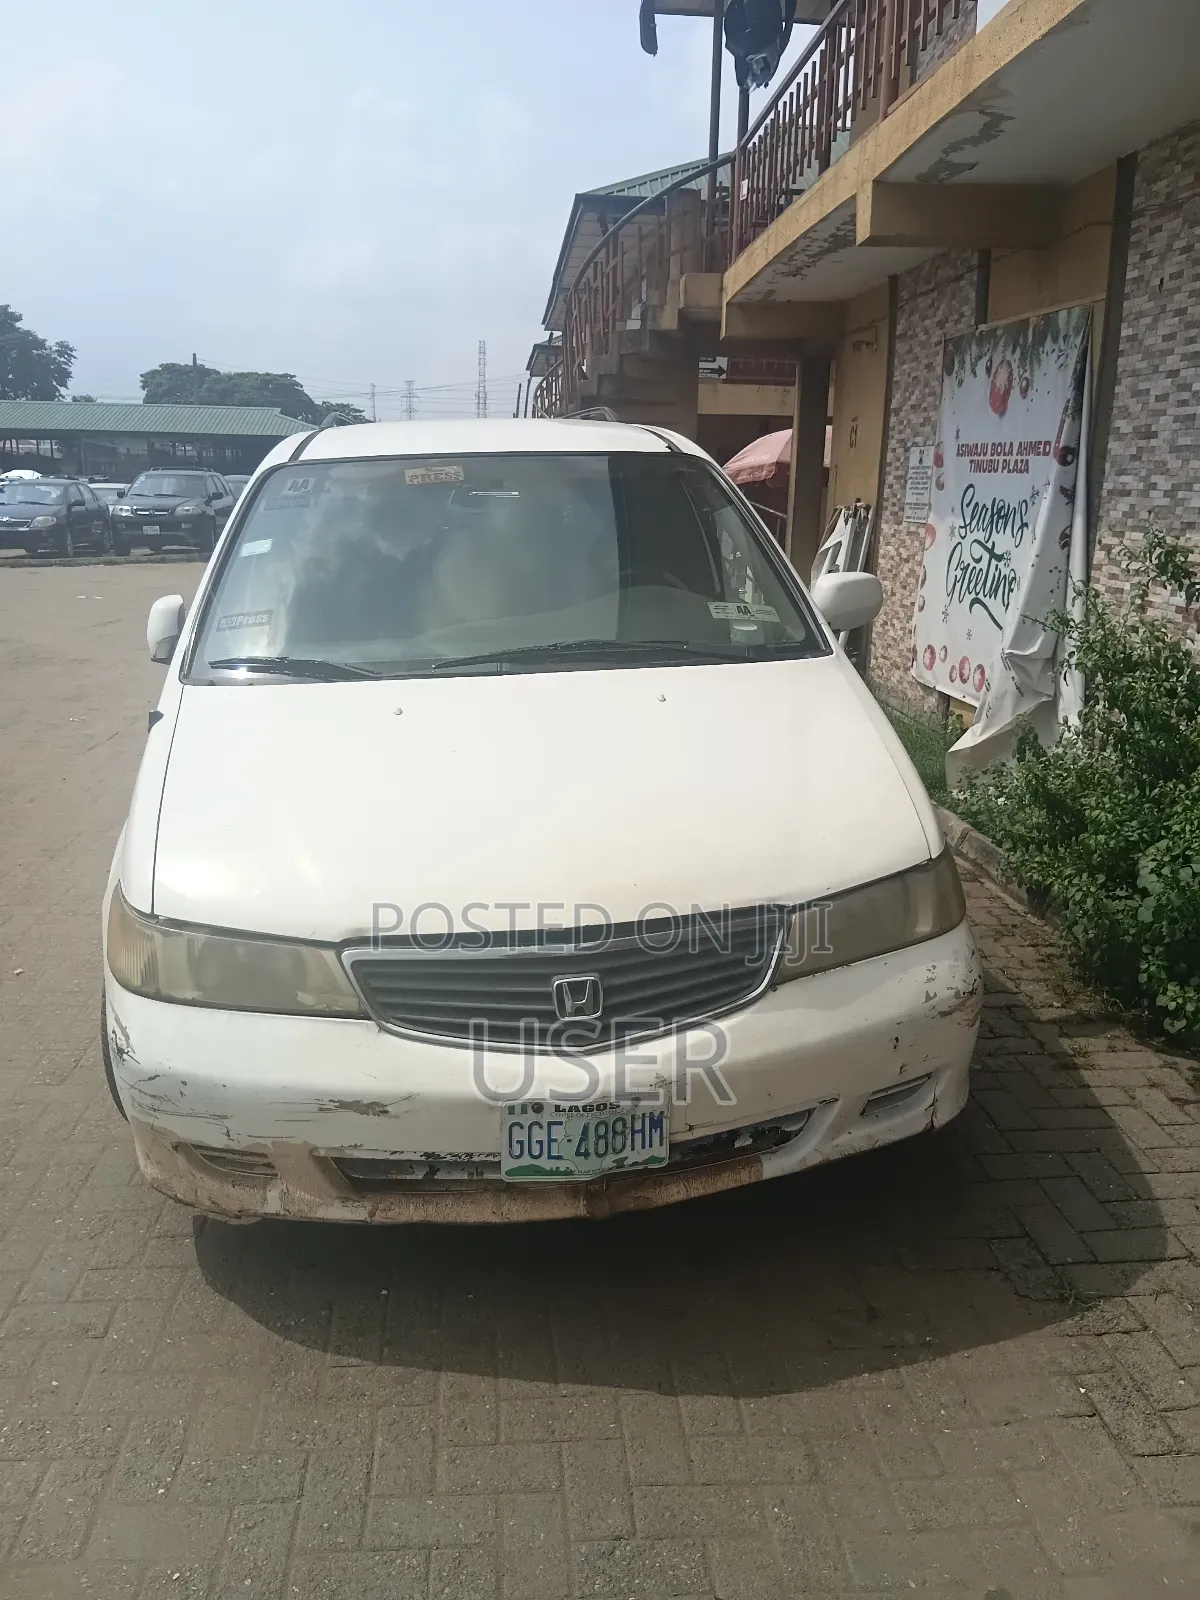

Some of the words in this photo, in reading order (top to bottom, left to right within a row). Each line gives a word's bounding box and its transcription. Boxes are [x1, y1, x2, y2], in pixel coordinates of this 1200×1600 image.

[956, 443, 989, 457] ASIWAJU
[990, 441, 1014, 457] BOLA
[1016, 440, 1052, 457] AHMED
[969, 458, 1000, 474] TINUBU
[1001, 458, 1030, 475] PLAZA
[409, 471, 461, 483] PRESS
[736, 605, 752, 615] AA
[554, 1102, 620, 1113] LAGOS
